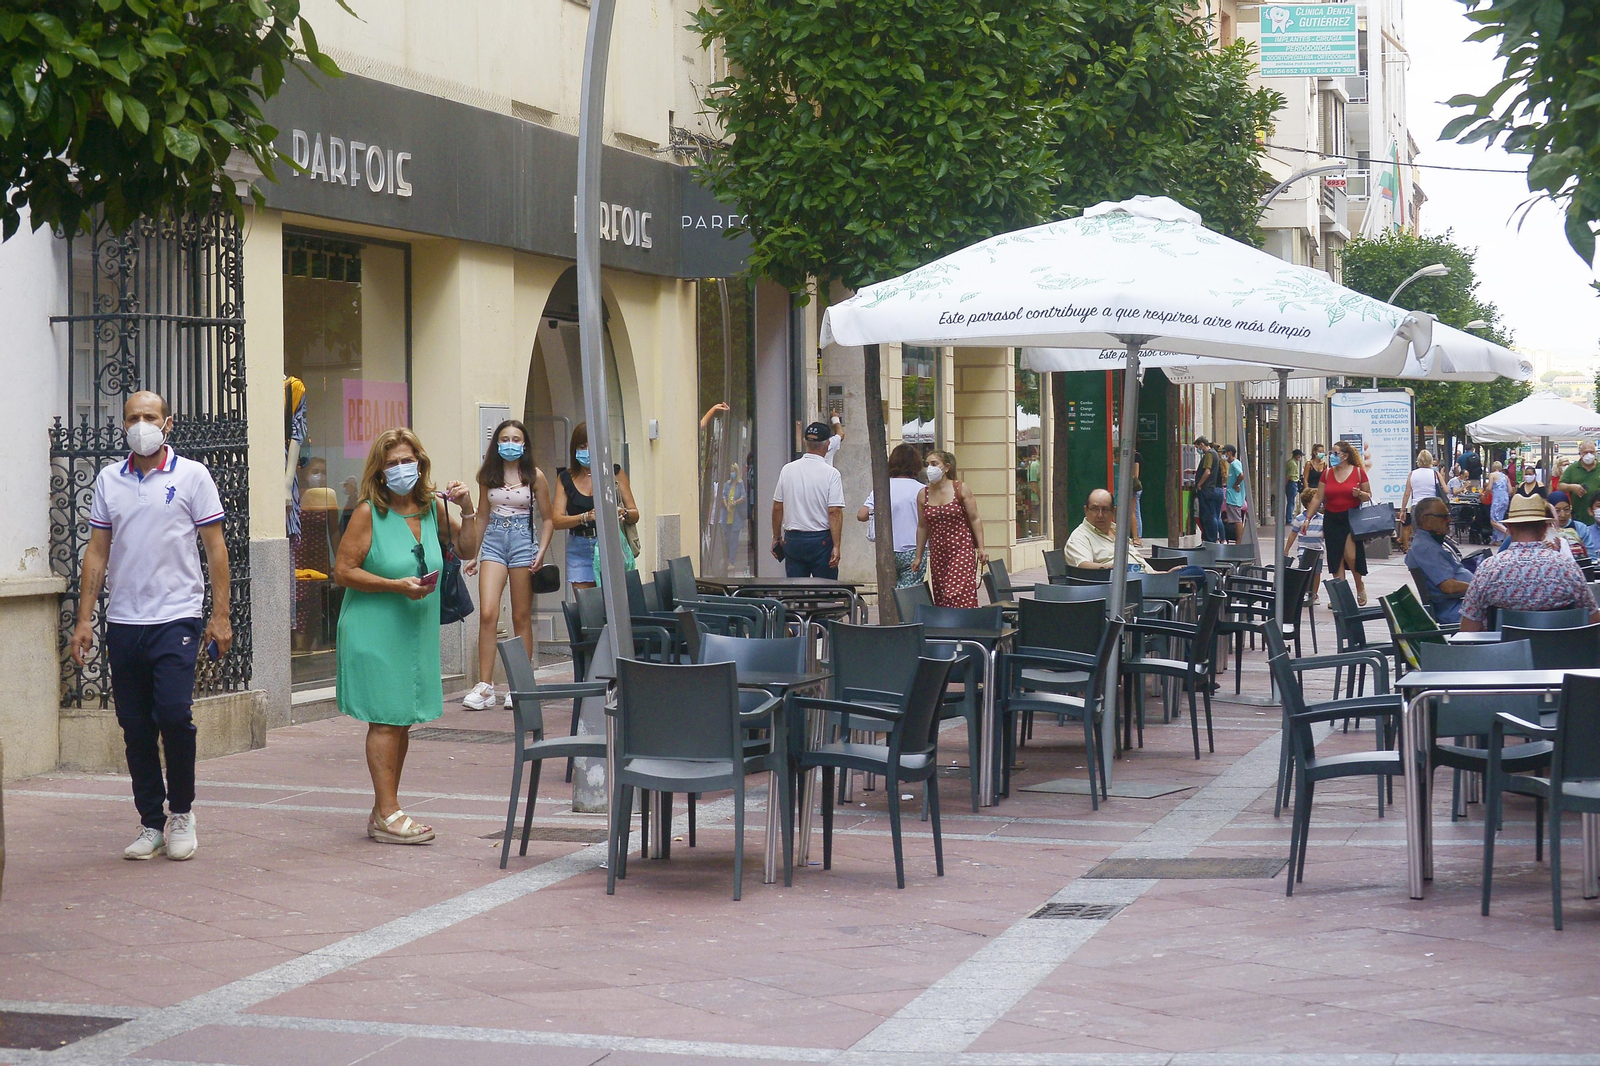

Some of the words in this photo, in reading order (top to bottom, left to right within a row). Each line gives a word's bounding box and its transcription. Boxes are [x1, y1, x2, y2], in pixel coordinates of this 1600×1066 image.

[1296, 7, 1323, 15] CLÍNICA
[1327, 6, 1354, 15] DENTAL
[1299, 16, 1351, 26] GUTIÉRREZ
[292, 129, 412, 197] PARFOIS
[574, 195, 652, 249] RFOIS
[938, 311, 965, 324] Este
[966, 307, 1024, 326] parasol
[1025, 304, 1099, 323] contribuye
[1102, 307, 1113, 317] a
[1116, 307, 1140, 322] que
[1143, 309, 1200, 325] respires
[1203, 316, 1232, 328] aire
[1235, 320, 1264, 332] más
[1268, 321, 1311, 339] limpio
[1099, 349, 1117, 359] Este
[348, 398, 404, 442] REBAJAS
